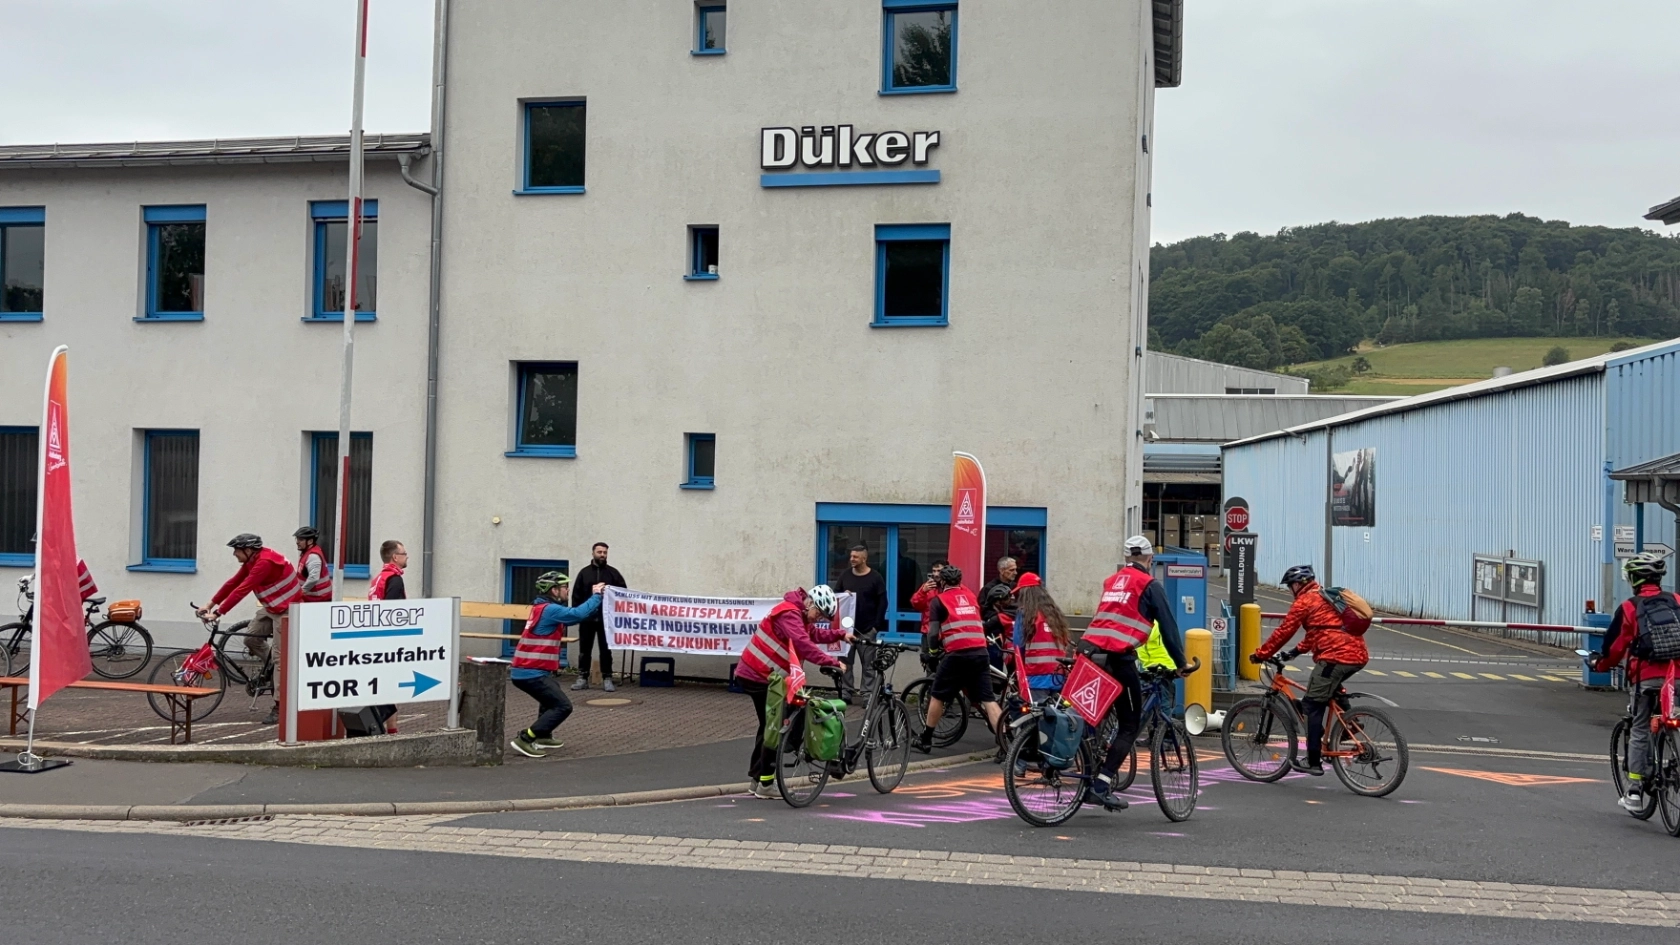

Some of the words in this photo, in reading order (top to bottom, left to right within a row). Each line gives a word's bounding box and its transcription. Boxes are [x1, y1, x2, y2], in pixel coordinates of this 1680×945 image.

[761, 124, 940, 170] Düker
[1227, 514, 1248, 524] STOP
[1231, 537, 1254, 545] LKW
[1238, 546, 1246, 594] ANMELDUNG
[614, 591, 640, 599] SCHLUSS
[653, 595, 692, 604] ABWICKLUNG
[330, 604, 424, 629] Düker
[614, 600, 647, 615] MEIN
[650, 603, 753, 620] ARBEITSPLATZ.
[614, 616, 657, 631] UNSER
[660, 620, 758, 635] INDUSTRIELAN
[814, 622, 830, 630] ETZT
[614, 632, 664, 647] UNSERE
[667, 636, 732, 651] ZUKUNFT.
[305, 645, 446, 668] Werkszufahrt
[307, 679, 359, 699] TOR
[367, 677, 378, 695] 1
